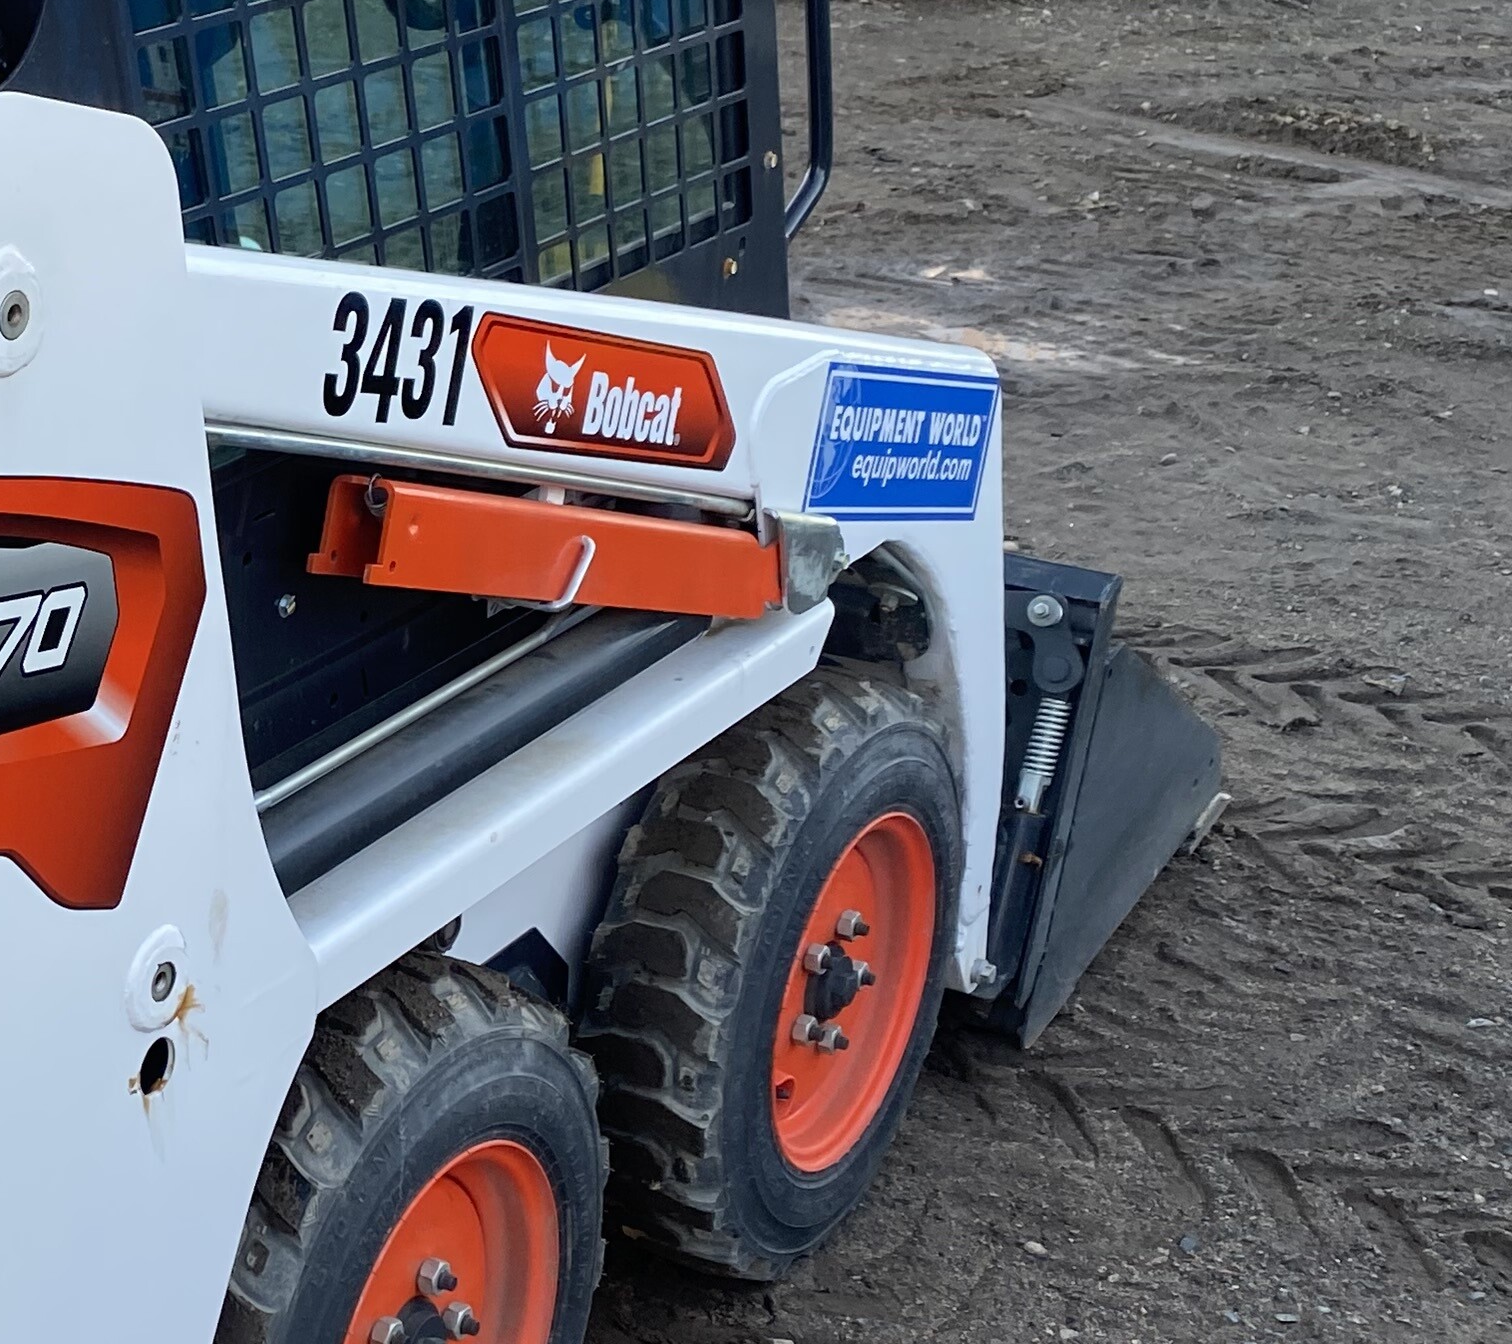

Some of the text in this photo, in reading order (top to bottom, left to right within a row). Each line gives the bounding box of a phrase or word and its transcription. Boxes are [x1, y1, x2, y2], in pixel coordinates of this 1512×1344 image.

[322, 291, 474, 426] 3431
[582, 371, 681, 445] Bobcat
[829, 405, 982, 447] EQUIPMENT WORLD
[851, 448, 973, 488] equipworld.com
